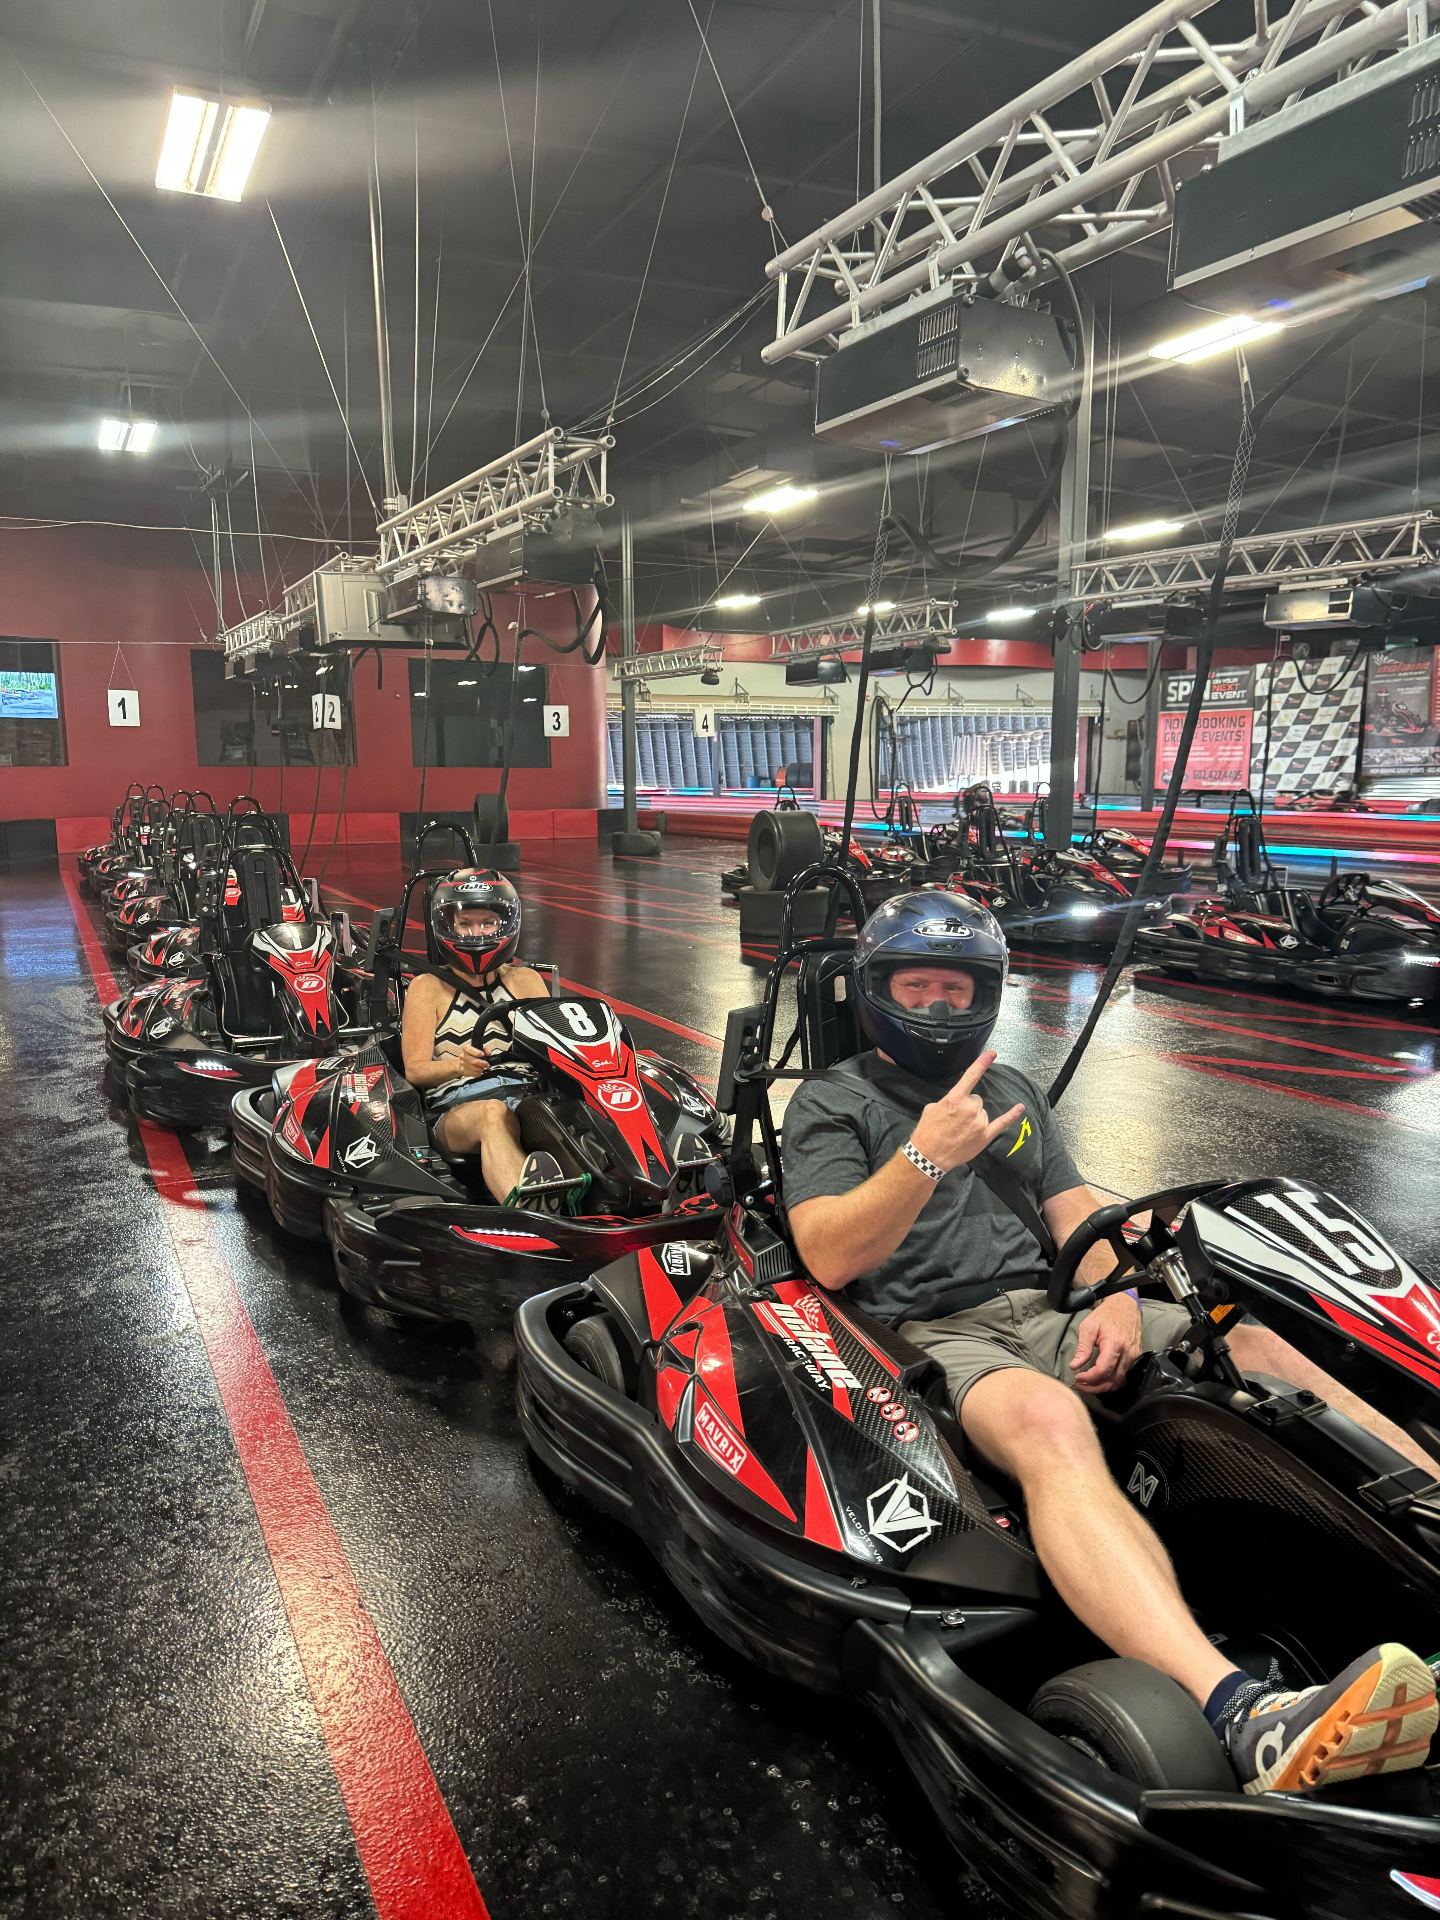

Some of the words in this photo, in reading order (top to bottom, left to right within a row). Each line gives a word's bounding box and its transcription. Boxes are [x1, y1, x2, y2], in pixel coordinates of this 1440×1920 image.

[1211, 690, 1246, 699] EVENT
[1212, 683, 1240, 691] NEXT
[117, 697, 127, 720] 1
[328, 701, 336, 723] 2
[552, 711, 561, 731] 3
[702, 714, 709, 733] 4
[1165, 719, 1185, 729] NO
[1202, 731, 1245, 742] EVENTS!
[558, 1002, 598, 1038] 8
[1253, 1191, 1395, 1275] 15
[697, 1408, 742, 1471] MAVRIX
[845, 1505, 875, 1548] VELOCITY
[873, 1549, 884, 1563] VR
